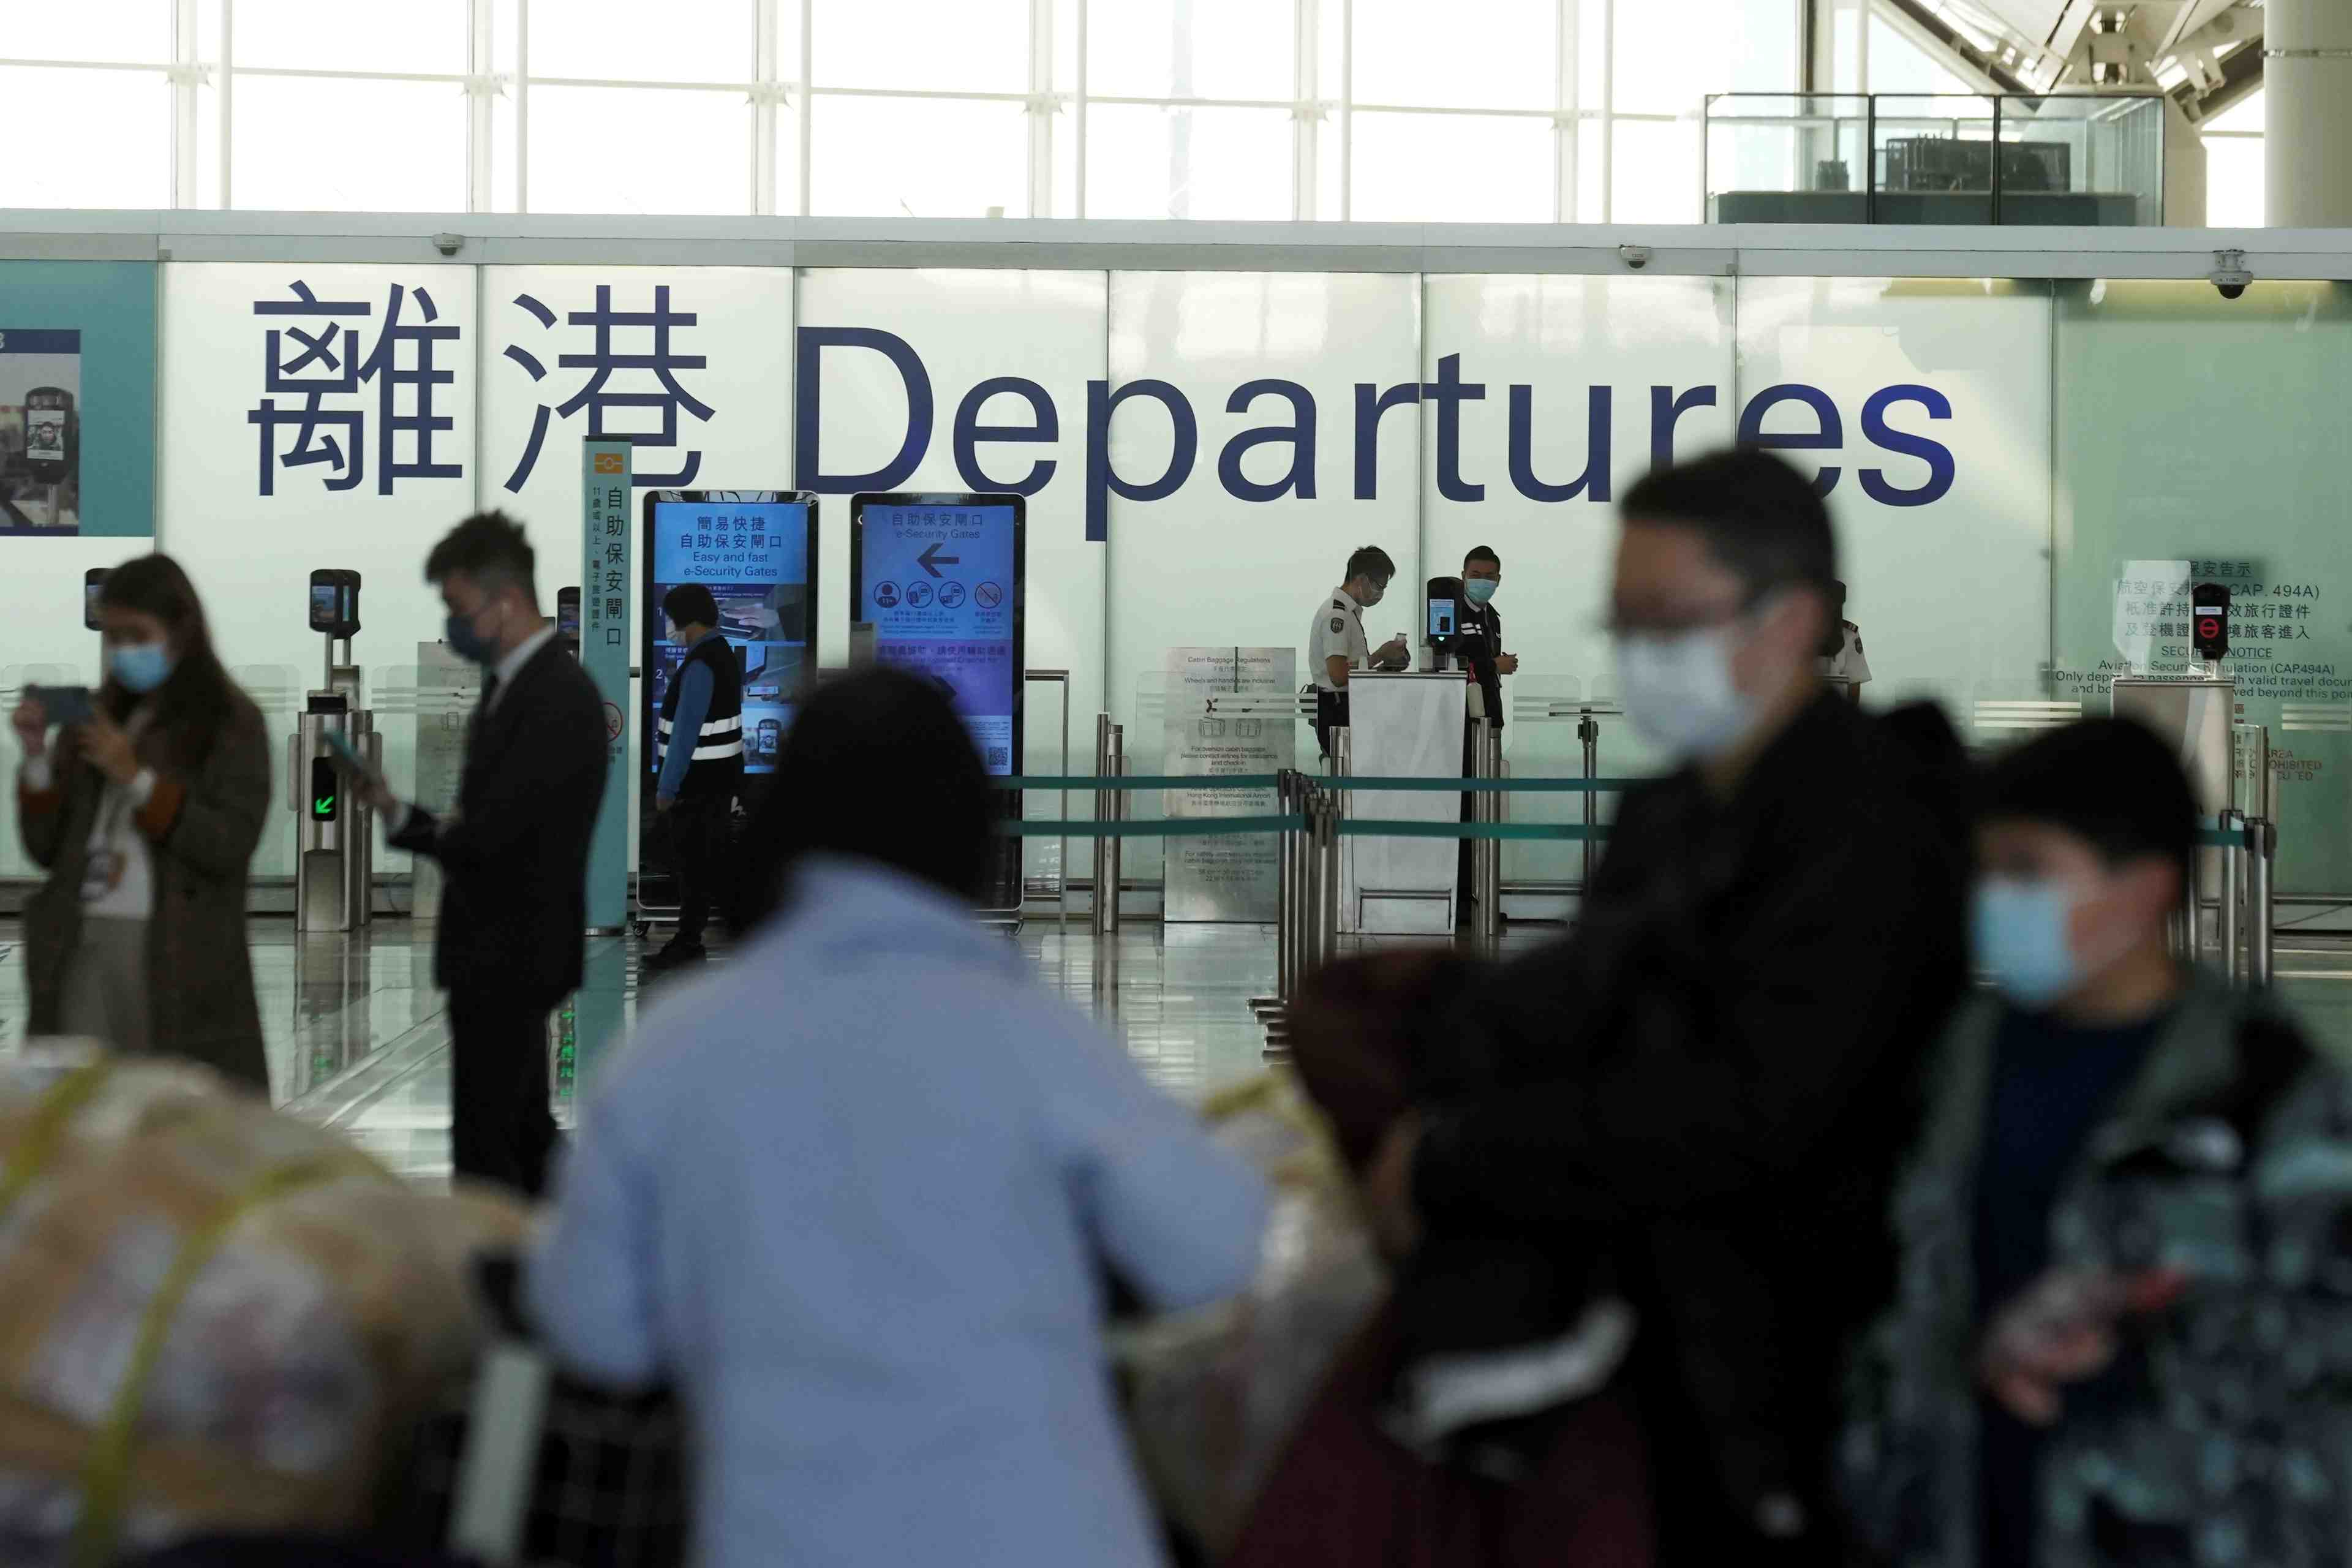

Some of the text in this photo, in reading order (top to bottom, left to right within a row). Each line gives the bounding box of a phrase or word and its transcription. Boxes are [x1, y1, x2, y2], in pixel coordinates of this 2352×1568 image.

[248, 279, 715, 496] 離港
[796, 326, 1956, 541] Departures
[697, 516, 766, 531] 簡易快捷
[892, 513, 983, 526] 自助保安閘口
[680, 533, 782, 549] 自助保安閘口
[896, 529, 980, 540] e-Security Gates
[693, 552, 769, 564] Easy and fast
[605, 487, 624, 646] 自助保安閘口
[684, 565, 778, 578] e-Security Gates
[2190, 561, 2251, 576] 保安告示
[2273, 584, 2320, 601] 494A)
[2125, 622, 2310, 639] 及登機證境旅客進入
[2227, 647, 2272, 658] NOTICE
[655, 669, 662, 679] 2
[2056, 671, 2082, 683] Only
[2248, 676, 2277, 686] valid
[2281, 676, 2314, 687] travel
[2071, 684, 2094, 693] and
[2258, 687, 2302, 699] beyond
[2305, 688, 2328, 699] this
[2268, 760, 2323, 770] OHIBITED
